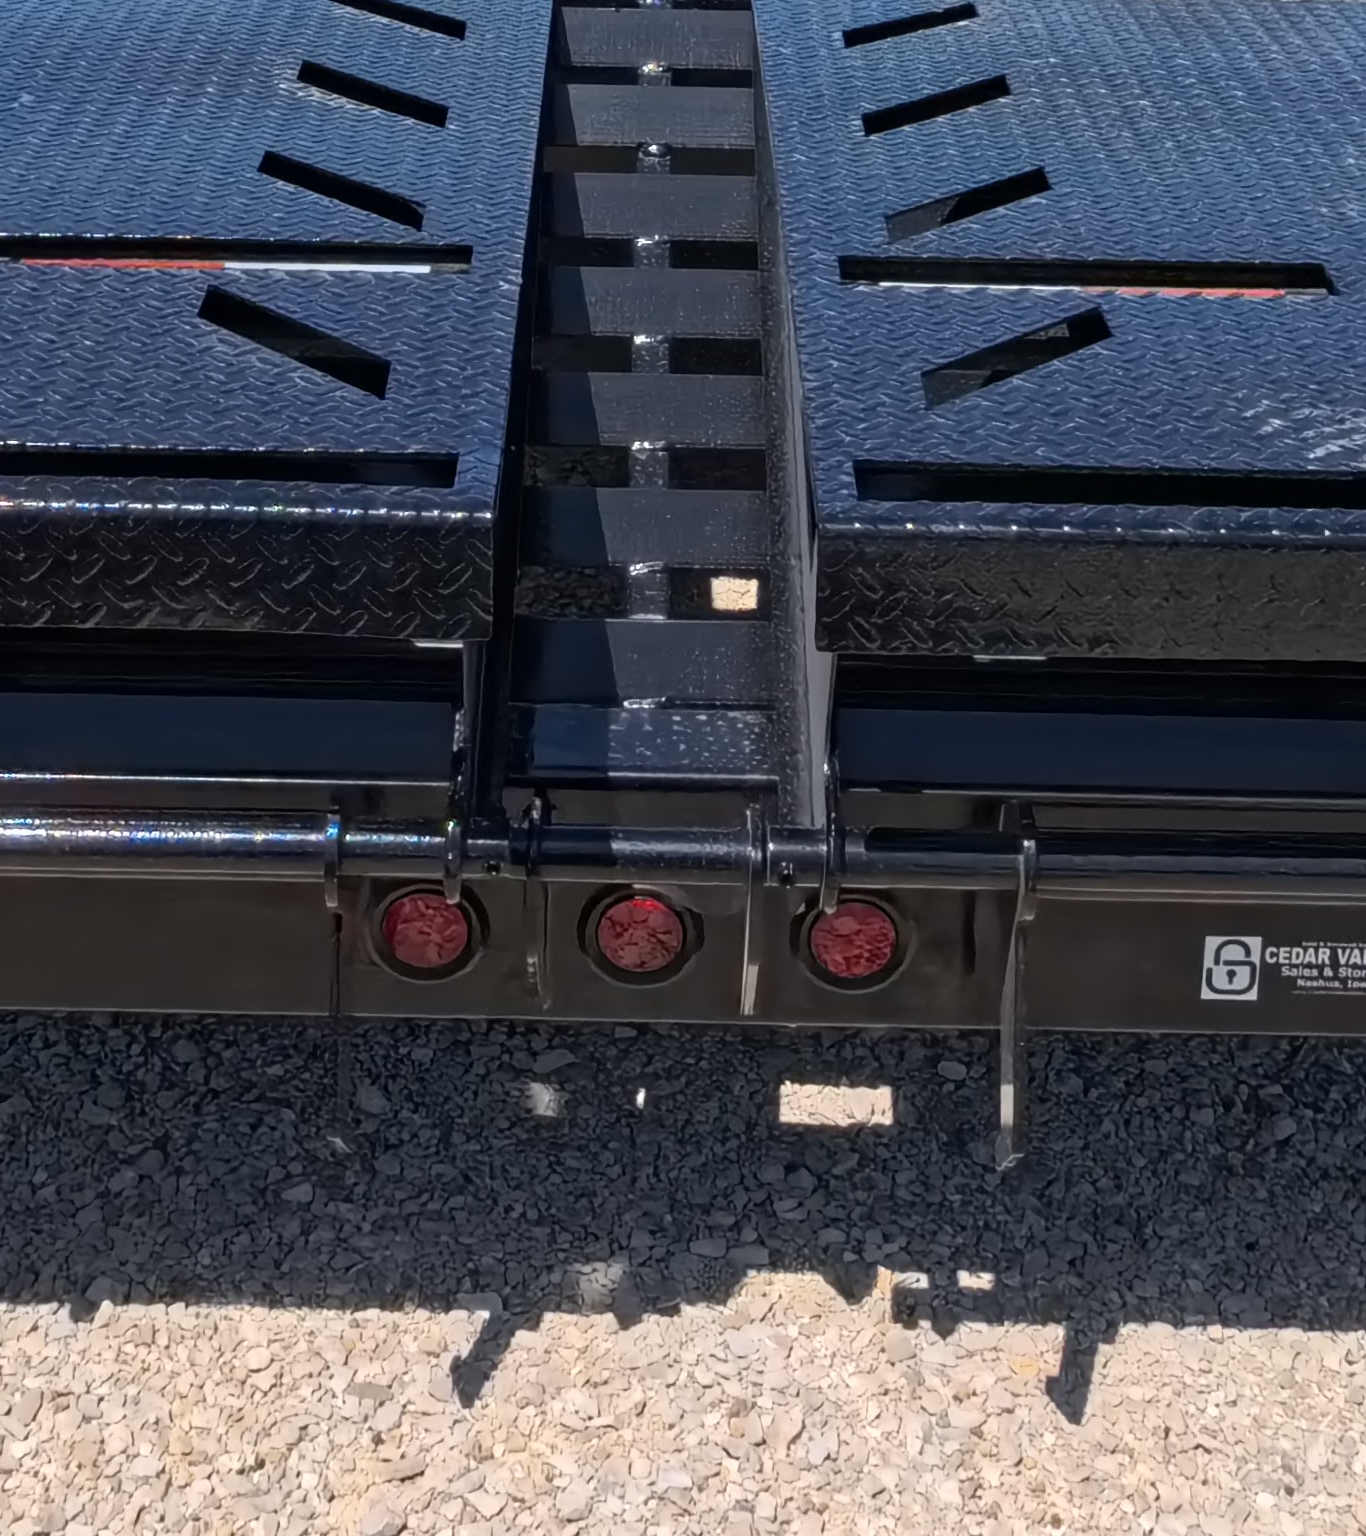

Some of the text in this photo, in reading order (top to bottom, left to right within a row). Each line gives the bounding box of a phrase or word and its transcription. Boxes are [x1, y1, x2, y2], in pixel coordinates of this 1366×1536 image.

[1265, 947, 1331, 964] CEDAR
[1281, 966, 1318, 977] Sales
[1323, 966, 1333, 977] &
[1297, 978, 1343, 989] Nashua,
